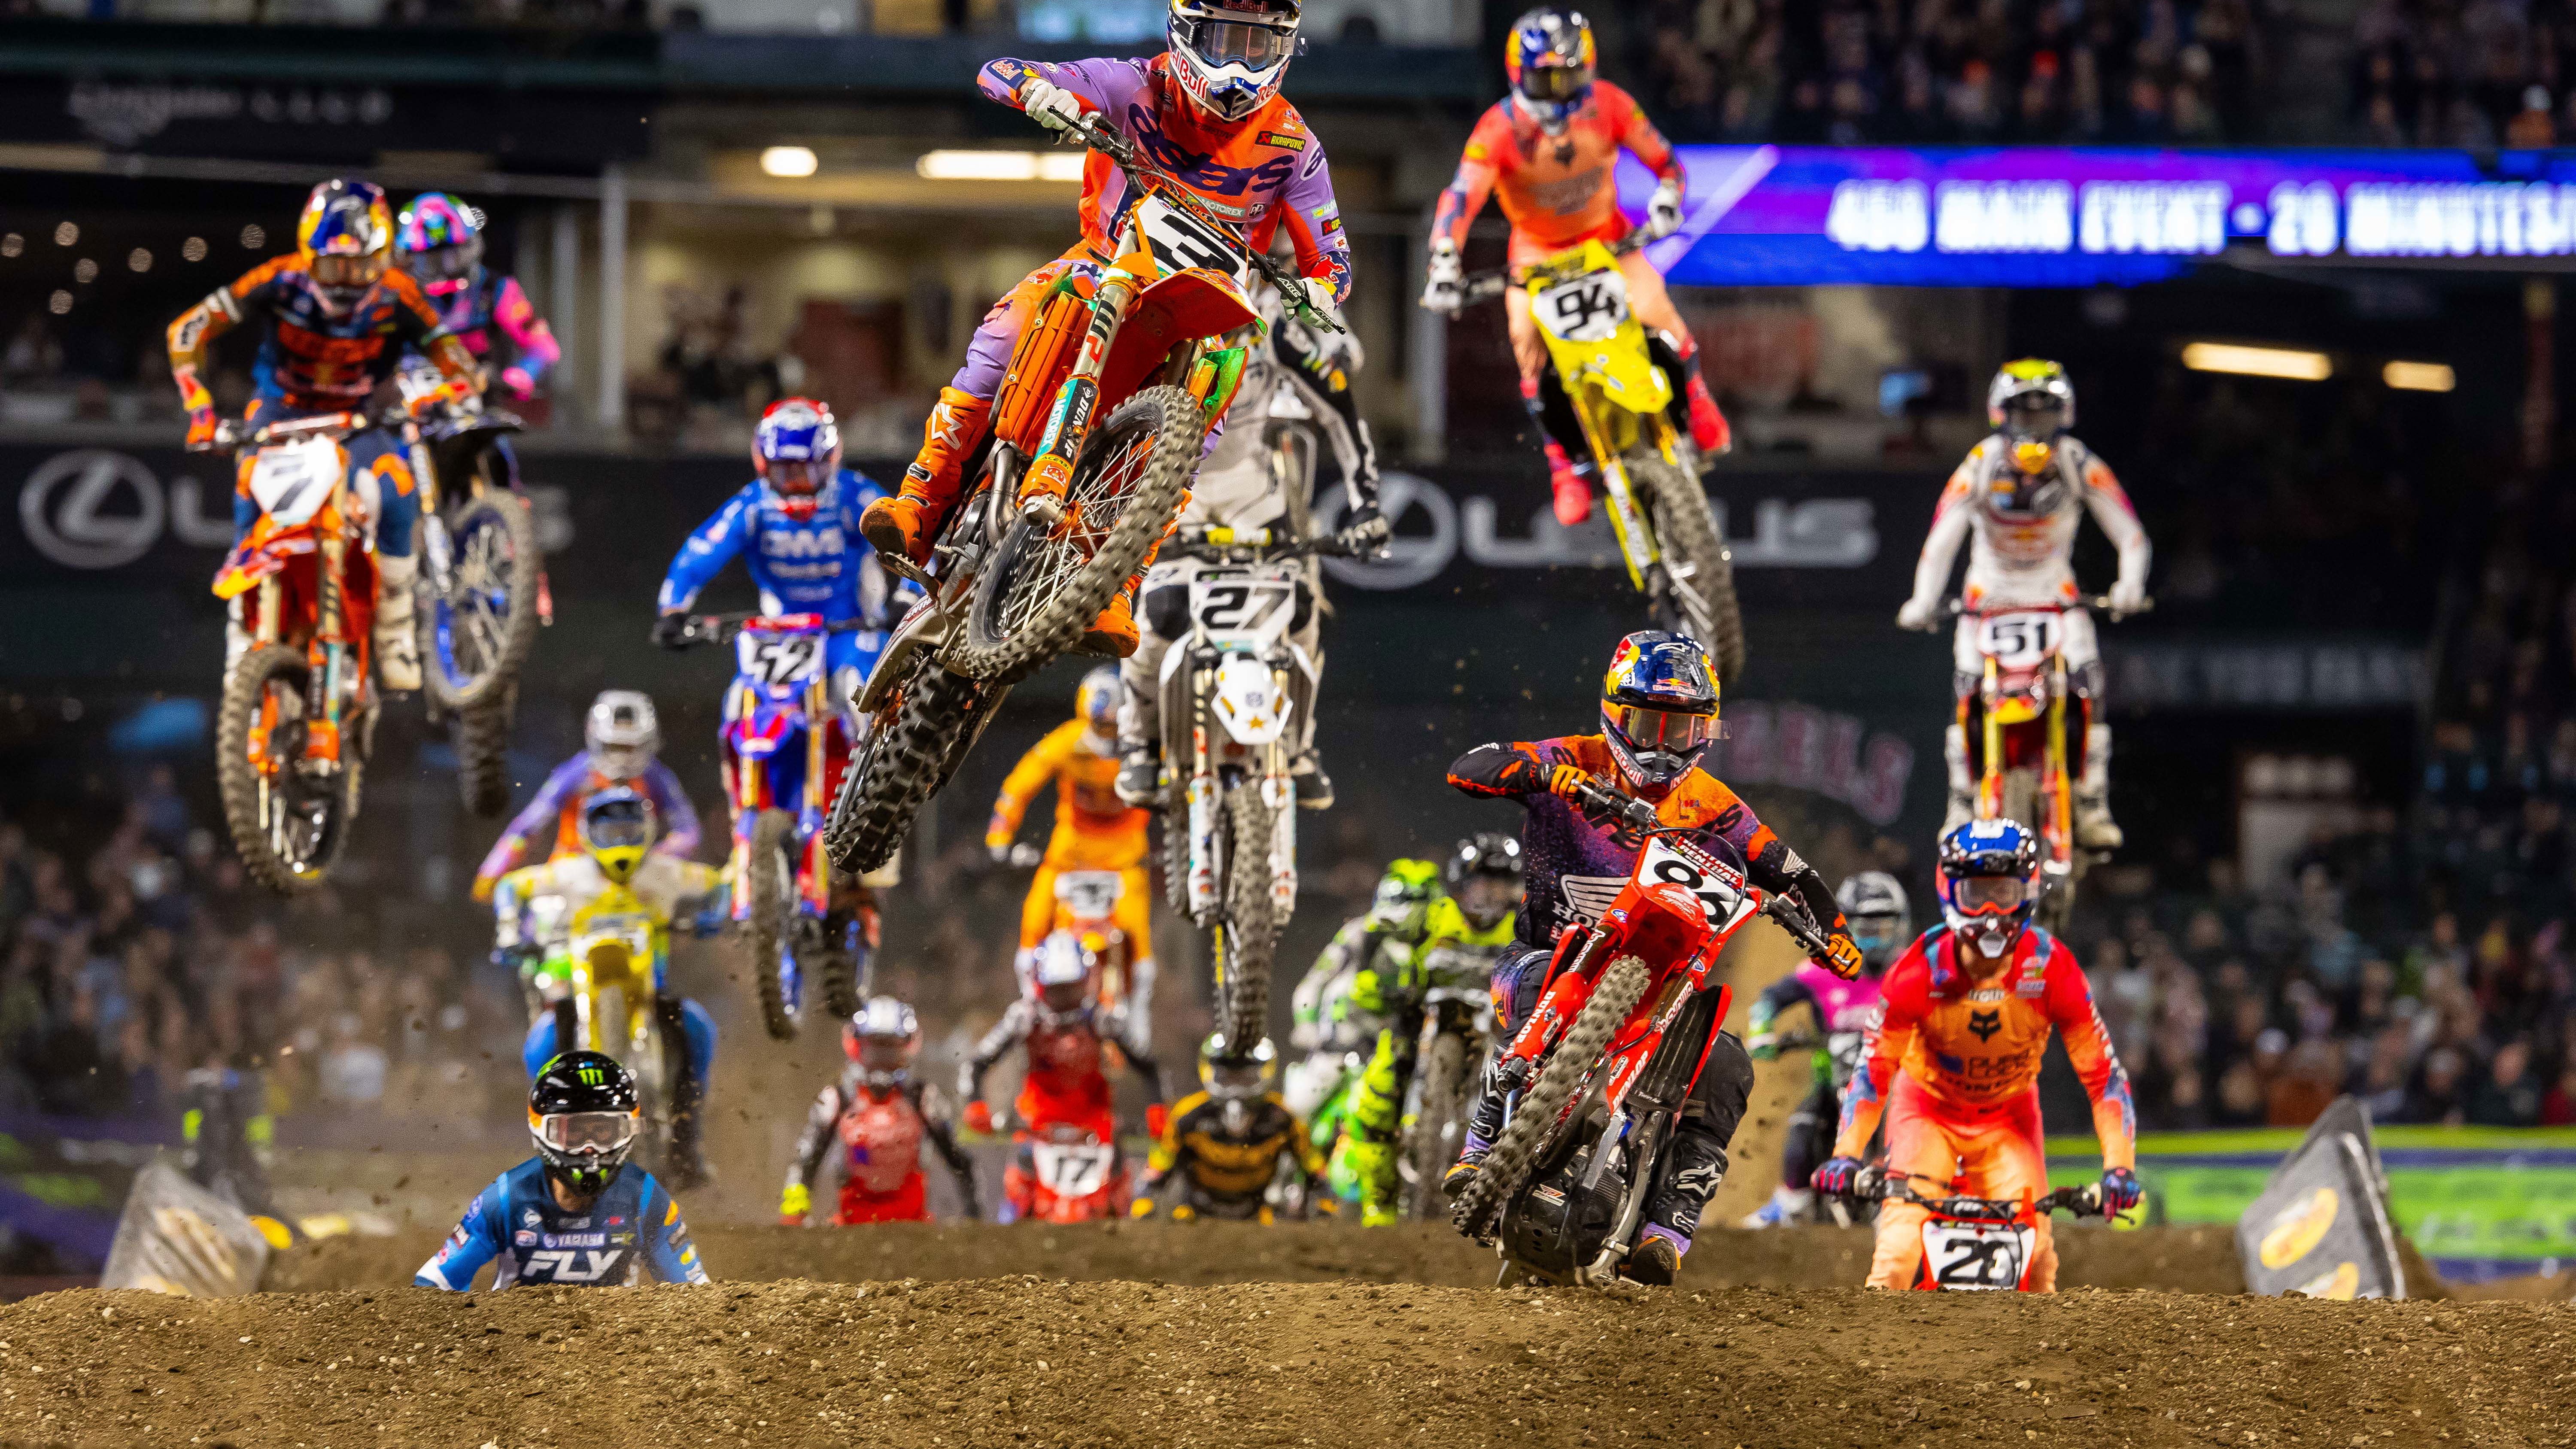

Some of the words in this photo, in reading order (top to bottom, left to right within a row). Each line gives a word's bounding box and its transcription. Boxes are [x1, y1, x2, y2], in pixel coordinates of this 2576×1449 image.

[1245, 1, 1269, 13] Bull
[1181, 59, 1210, 101] Bull
[1934, 179, 2075, 254] MAIN
[2080, 180, 2231, 255] EVENT
[1146, 214, 1240, 278] 3
[1277, 277, 1302, 298] ARC
[1555, 283, 1618, 333] 94
[1041, 398, 1067, 449] MOTOREX
[1200, 587, 1290, 630] 27
[1990, 620, 2048, 656] 51
[752, 636, 818, 685] 52
[1679, 844, 1738, 884] RENTHAL
[1516, 991, 1556, 1044] DUNLOP
[1053, 1155, 1097, 1184] 17
[522, 1250, 624, 1281] FLY
